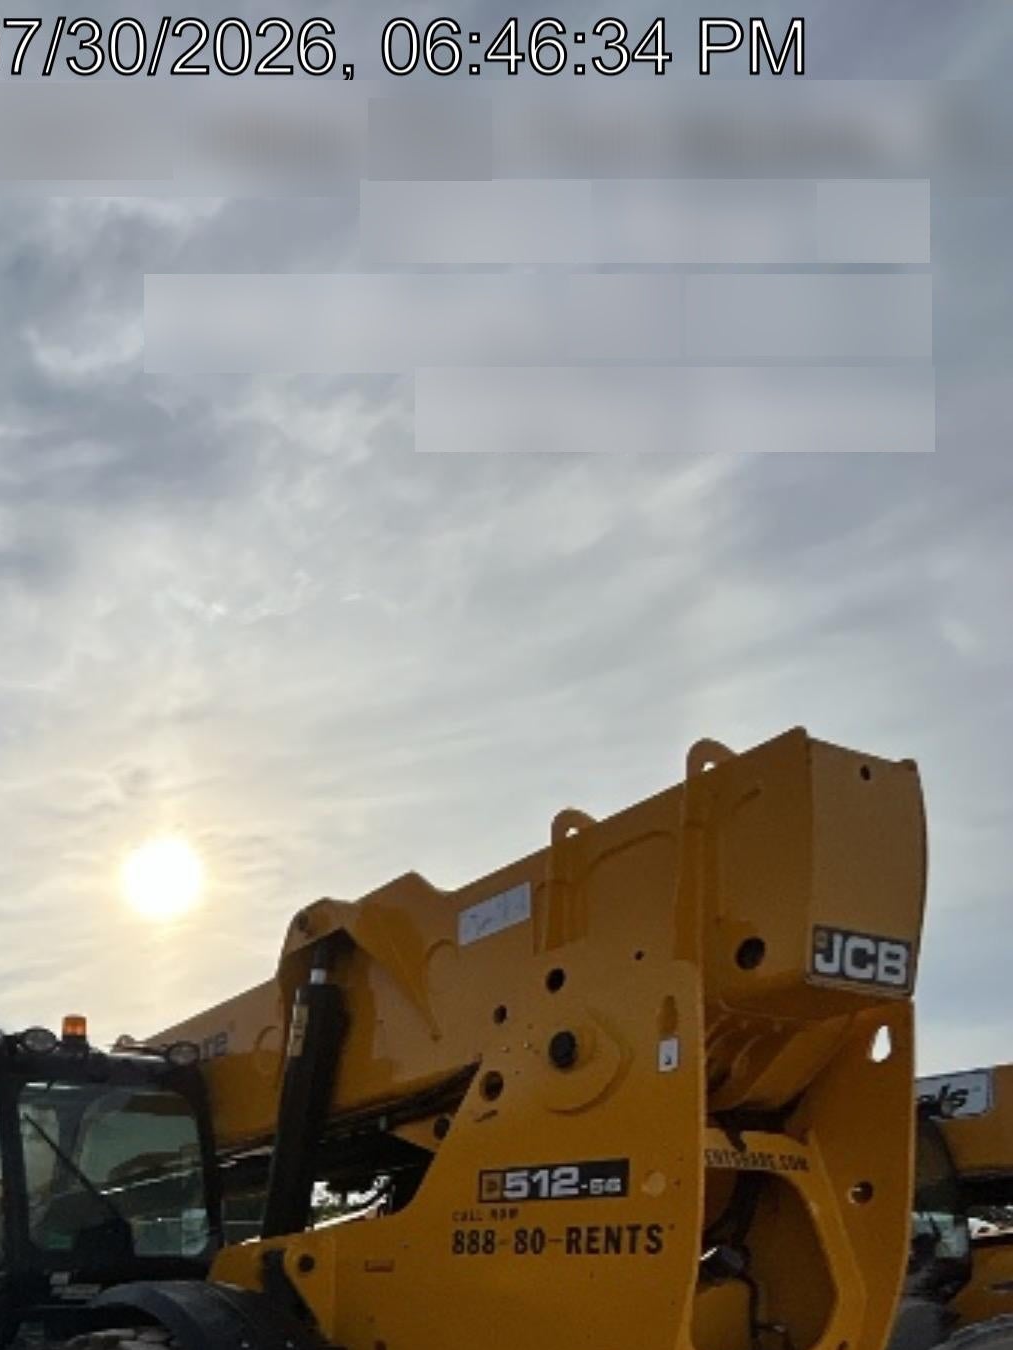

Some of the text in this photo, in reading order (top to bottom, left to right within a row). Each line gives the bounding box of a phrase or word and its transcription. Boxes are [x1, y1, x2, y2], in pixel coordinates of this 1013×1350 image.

[814, 934, 909, 985] JCB
[452, 1209, 484, 1222] CALL
[451, 1223, 664, 1256] 888-80-RENTS
